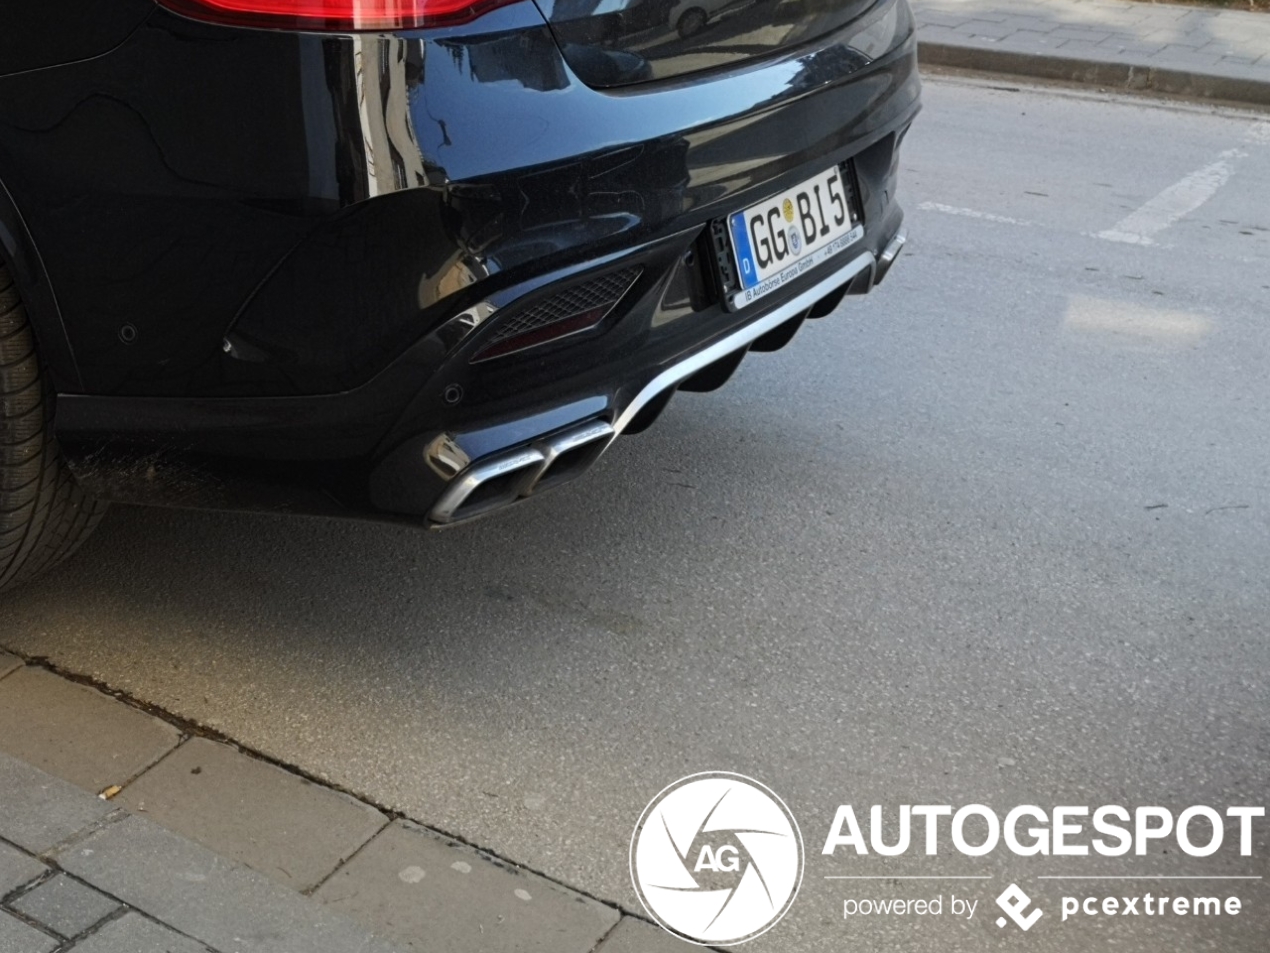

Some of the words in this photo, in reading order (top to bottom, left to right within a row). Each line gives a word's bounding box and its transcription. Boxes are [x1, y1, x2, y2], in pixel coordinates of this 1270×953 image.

[742, 257, 751, 275] D
[750, 207, 789, 269] GG
[780, 269, 798, 283] Europa
